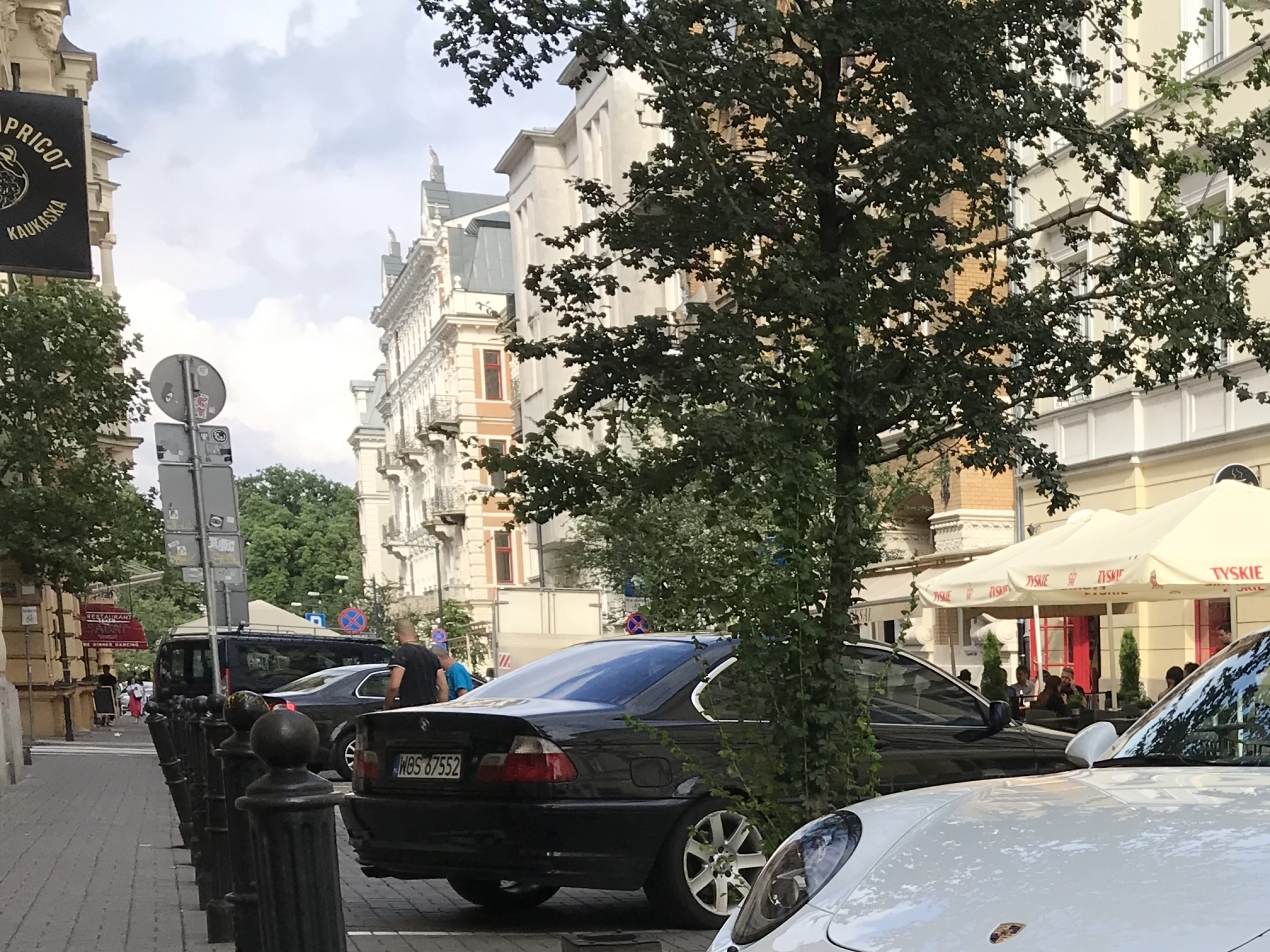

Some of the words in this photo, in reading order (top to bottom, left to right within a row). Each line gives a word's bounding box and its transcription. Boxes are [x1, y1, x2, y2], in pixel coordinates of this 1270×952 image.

[0, 117, 72, 170] PRICOT
[7, 199, 67, 240] KAUKASKA
[1025, 574, 1050, 587] TYSKIE
[1209, 565, 1264, 580] TYSKIE
[425, 756, 460, 776] 67552
